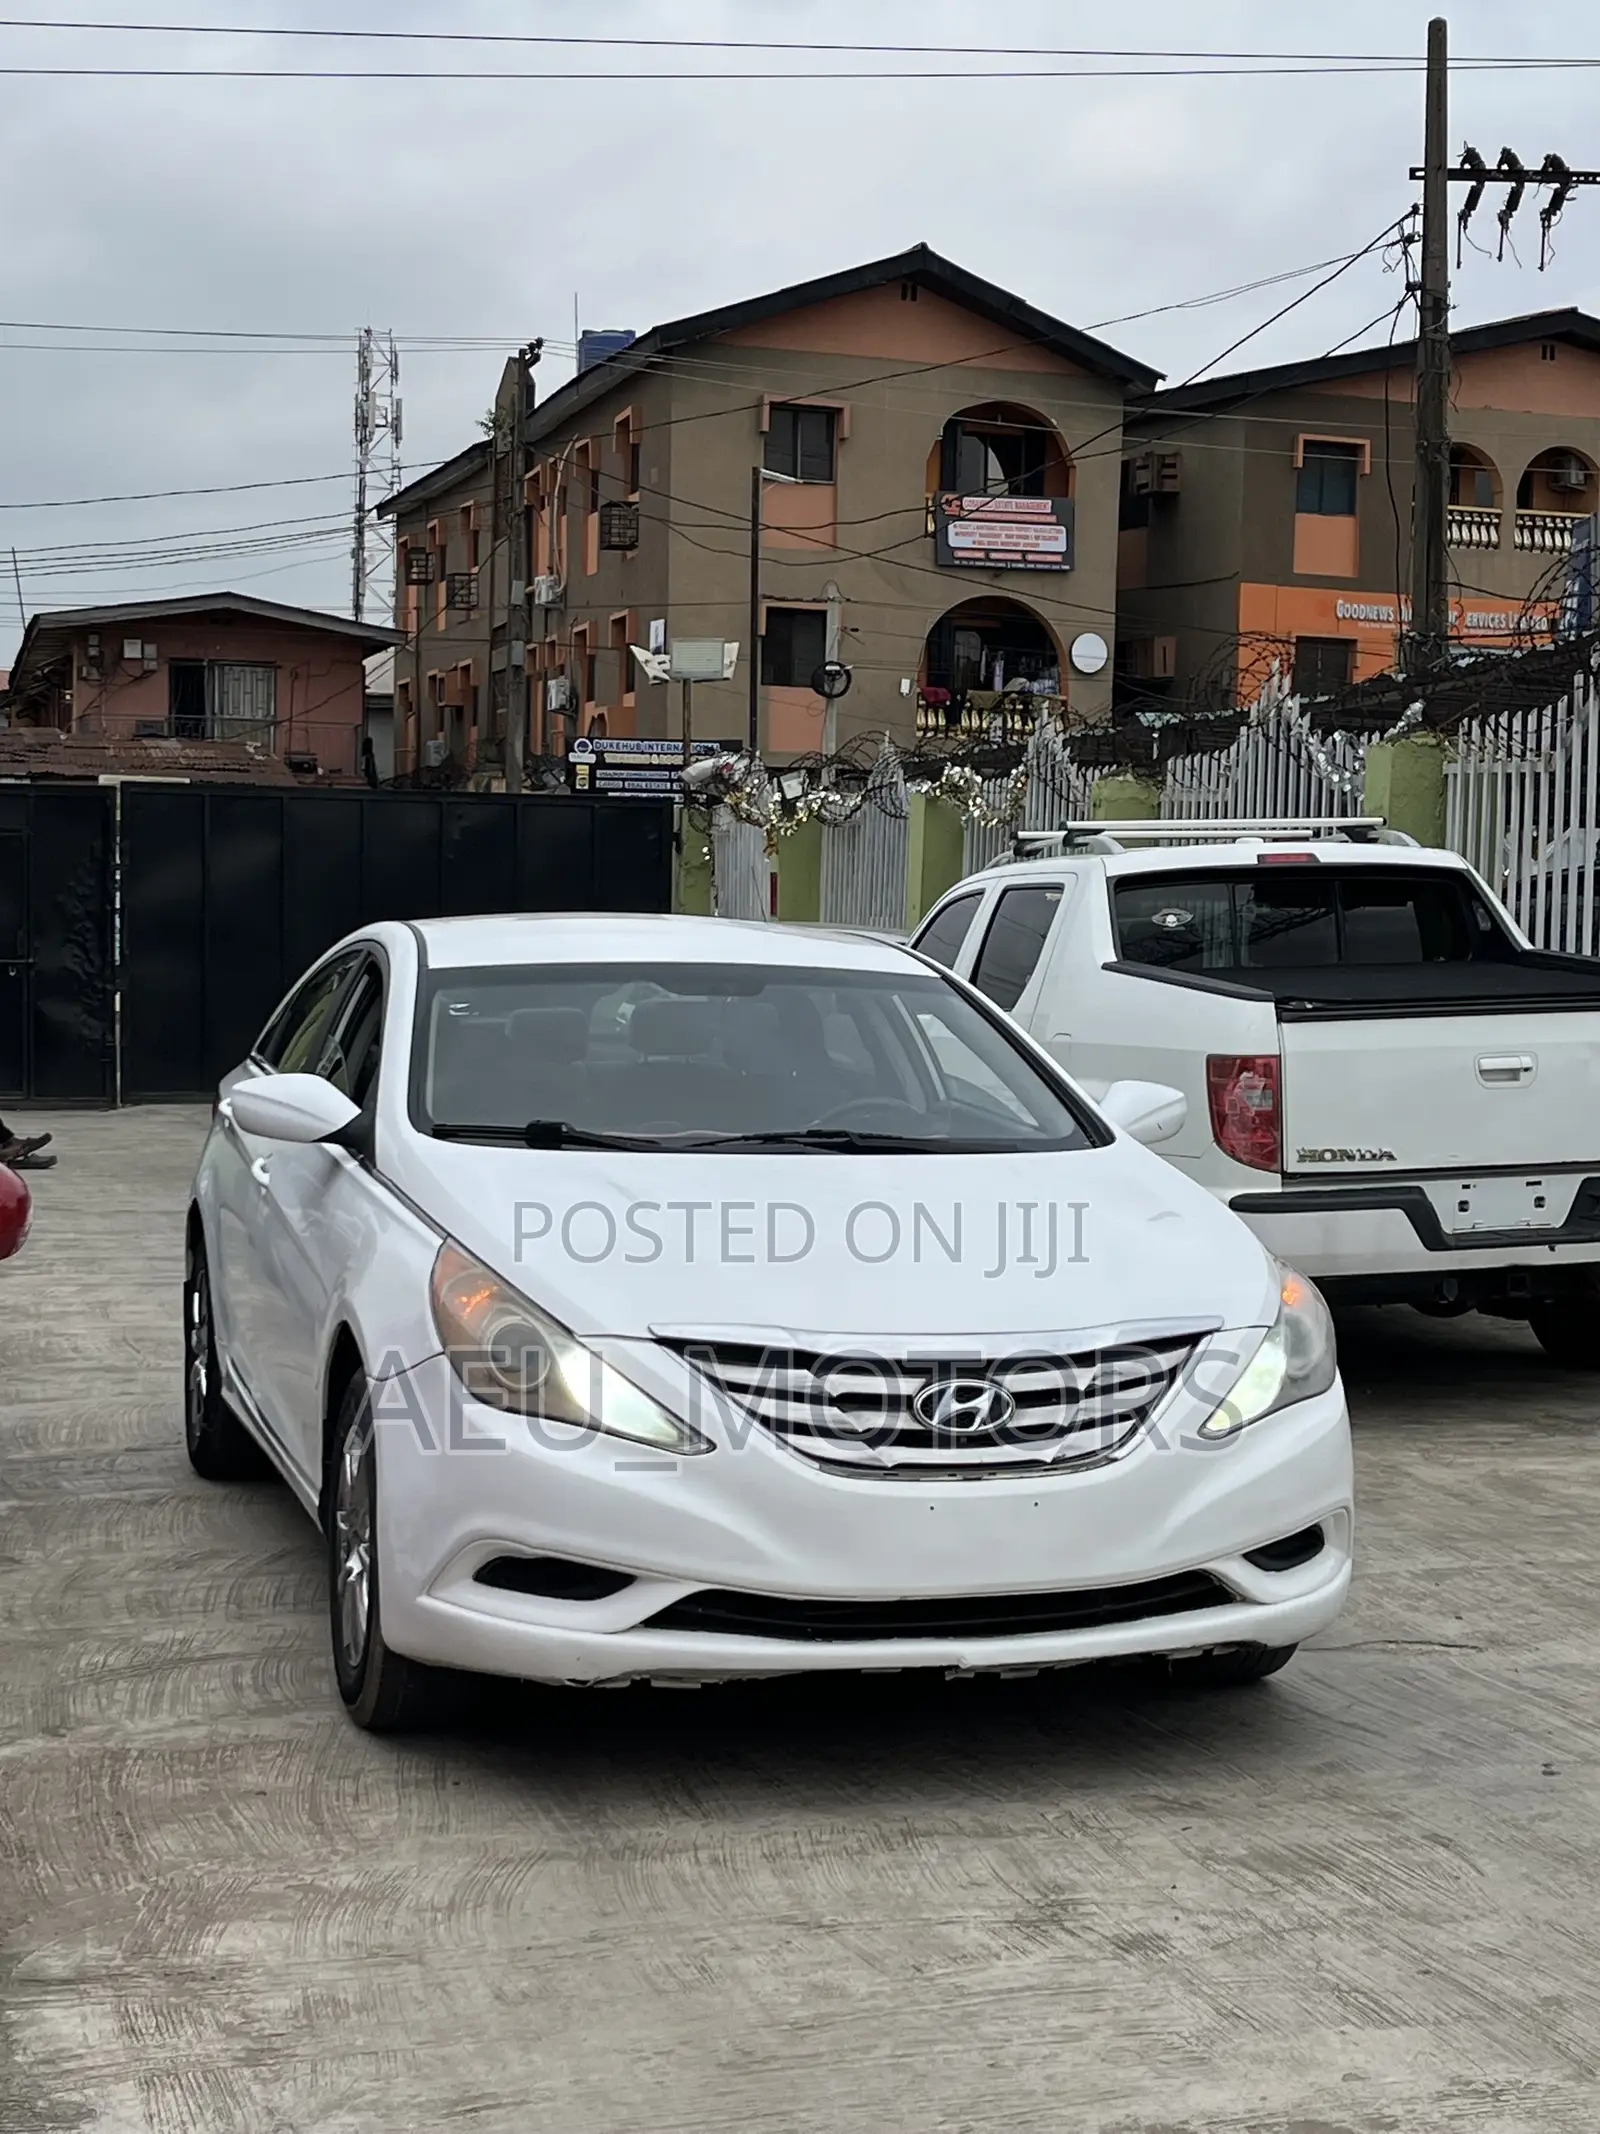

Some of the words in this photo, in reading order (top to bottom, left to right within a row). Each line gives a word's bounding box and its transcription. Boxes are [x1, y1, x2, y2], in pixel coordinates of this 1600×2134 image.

[1336, 599, 1394, 621] GOODNEWS
[1463, 610, 1506, 629] ERVICES
[594, 740, 642, 752] DUKEHUB
[1296, 1147, 1397, 1163] HONDA
